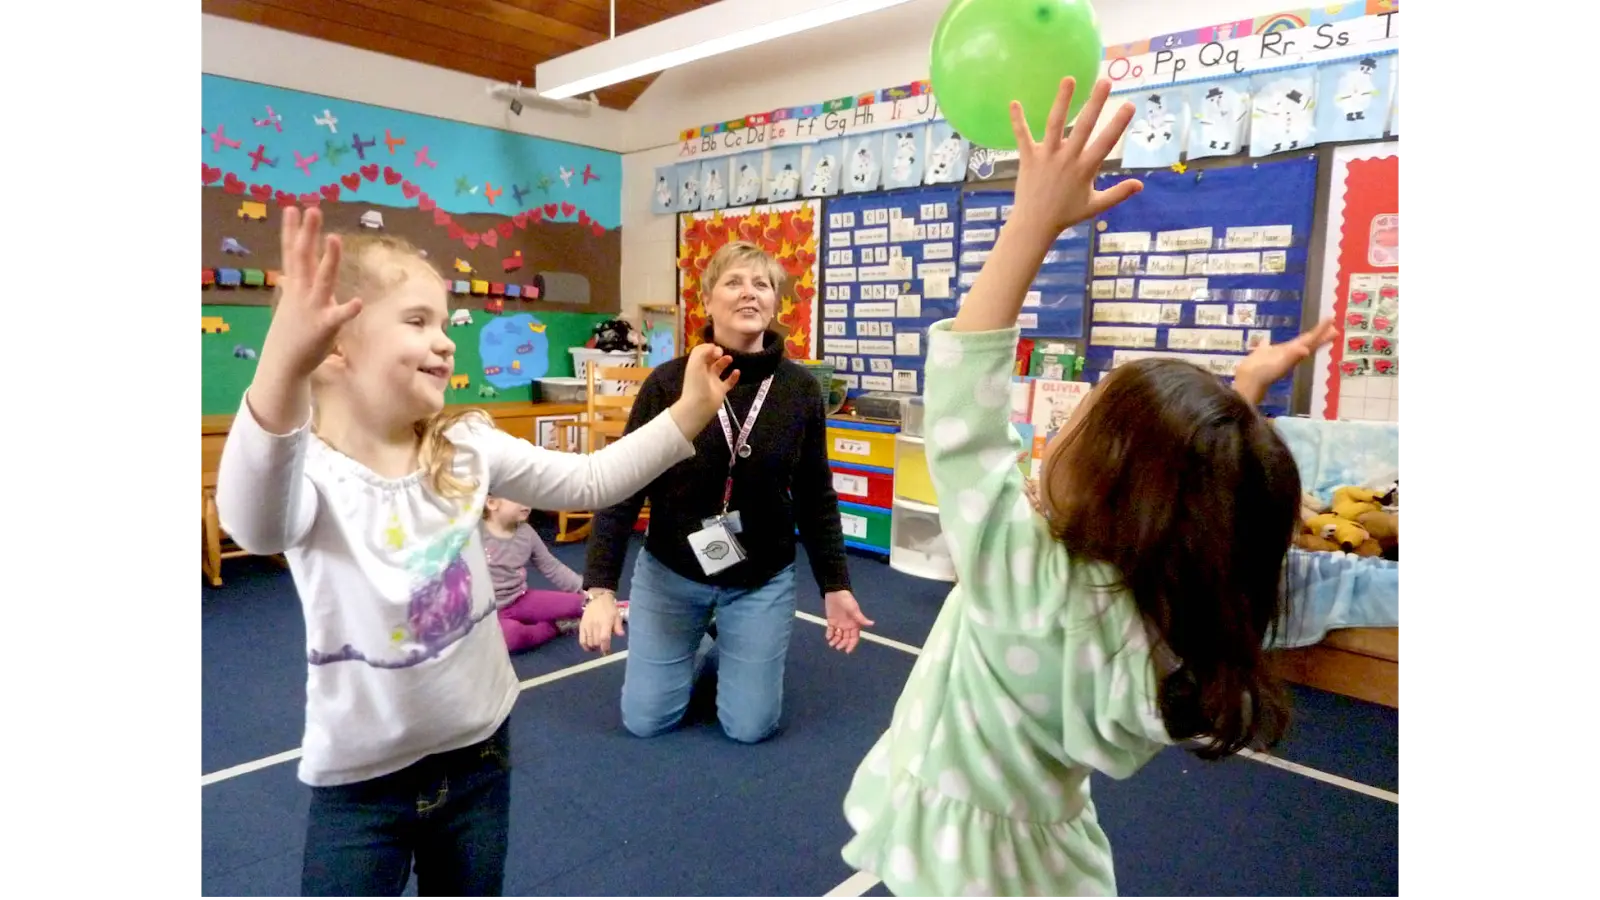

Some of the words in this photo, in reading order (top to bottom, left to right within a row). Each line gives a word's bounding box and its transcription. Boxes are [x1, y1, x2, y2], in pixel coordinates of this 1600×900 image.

[1107, 57, 1143, 81] Oo
[1153, 50, 1186, 82] Pp
[1198, 41, 1245, 74] Qq
[1259, 32, 1295, 59] Rr
[1312, 23, 1350, 50] Ss
[679, 139, 697, 157] Aa
[701, 135, 717, 153] Bb
[723, 130, 742, 148] Cc
[746, 125, 765, 145] Dd
[770, 123, 786, 140] Ee
[796, 117, 818, 137] Ff
[824, 111, 848, 137] Gg
[853, 104, 875, 127] Hh
[890, 100, 902, 120] Ii
[1361, 320, 1368, 330] 8
[1042, 382, 1081, 393] OLIVIA
